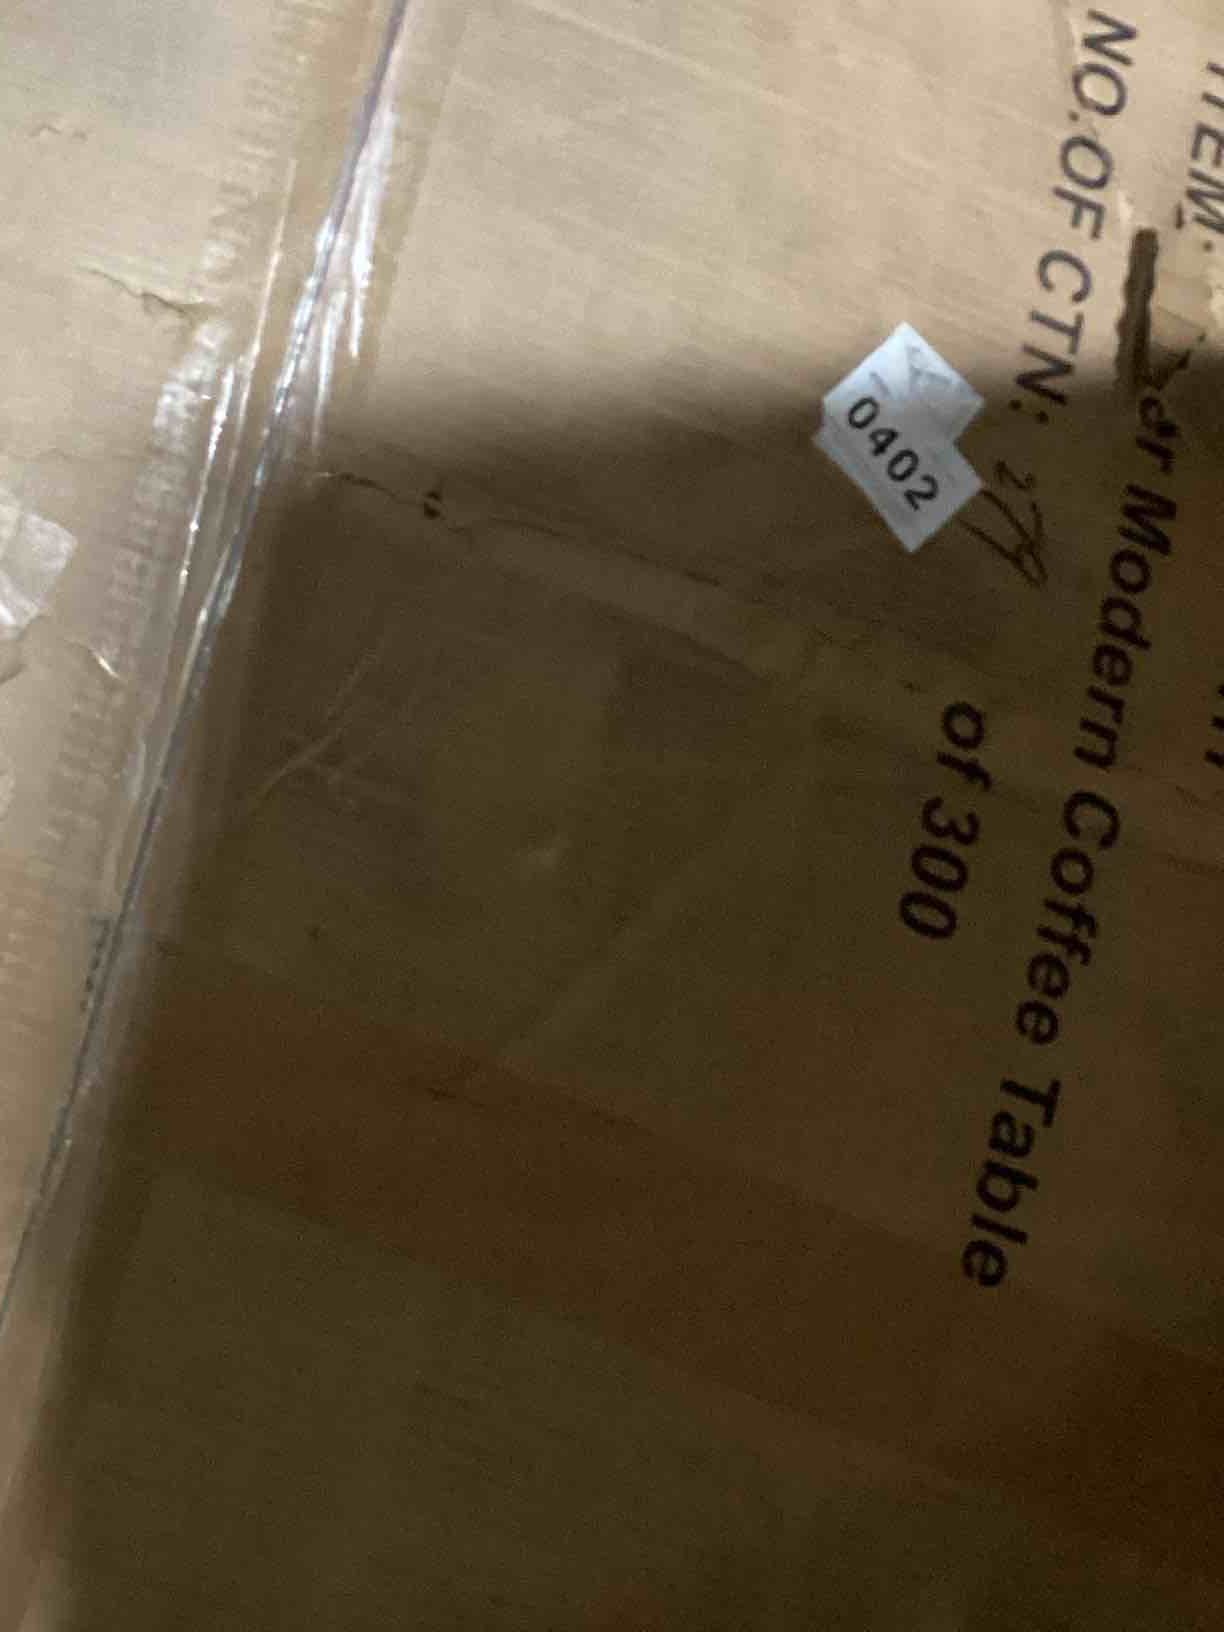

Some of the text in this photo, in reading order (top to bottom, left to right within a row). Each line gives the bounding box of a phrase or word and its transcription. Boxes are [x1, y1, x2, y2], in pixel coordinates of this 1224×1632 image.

[846, 395, 940, 512] 0402
[1074, 482, 1178, 772] Modern
[898, 701, 992, 940] of 300
[1016, 790, 1121, 1048] Coffee
[961, 1076, 1062, 1290] Table
